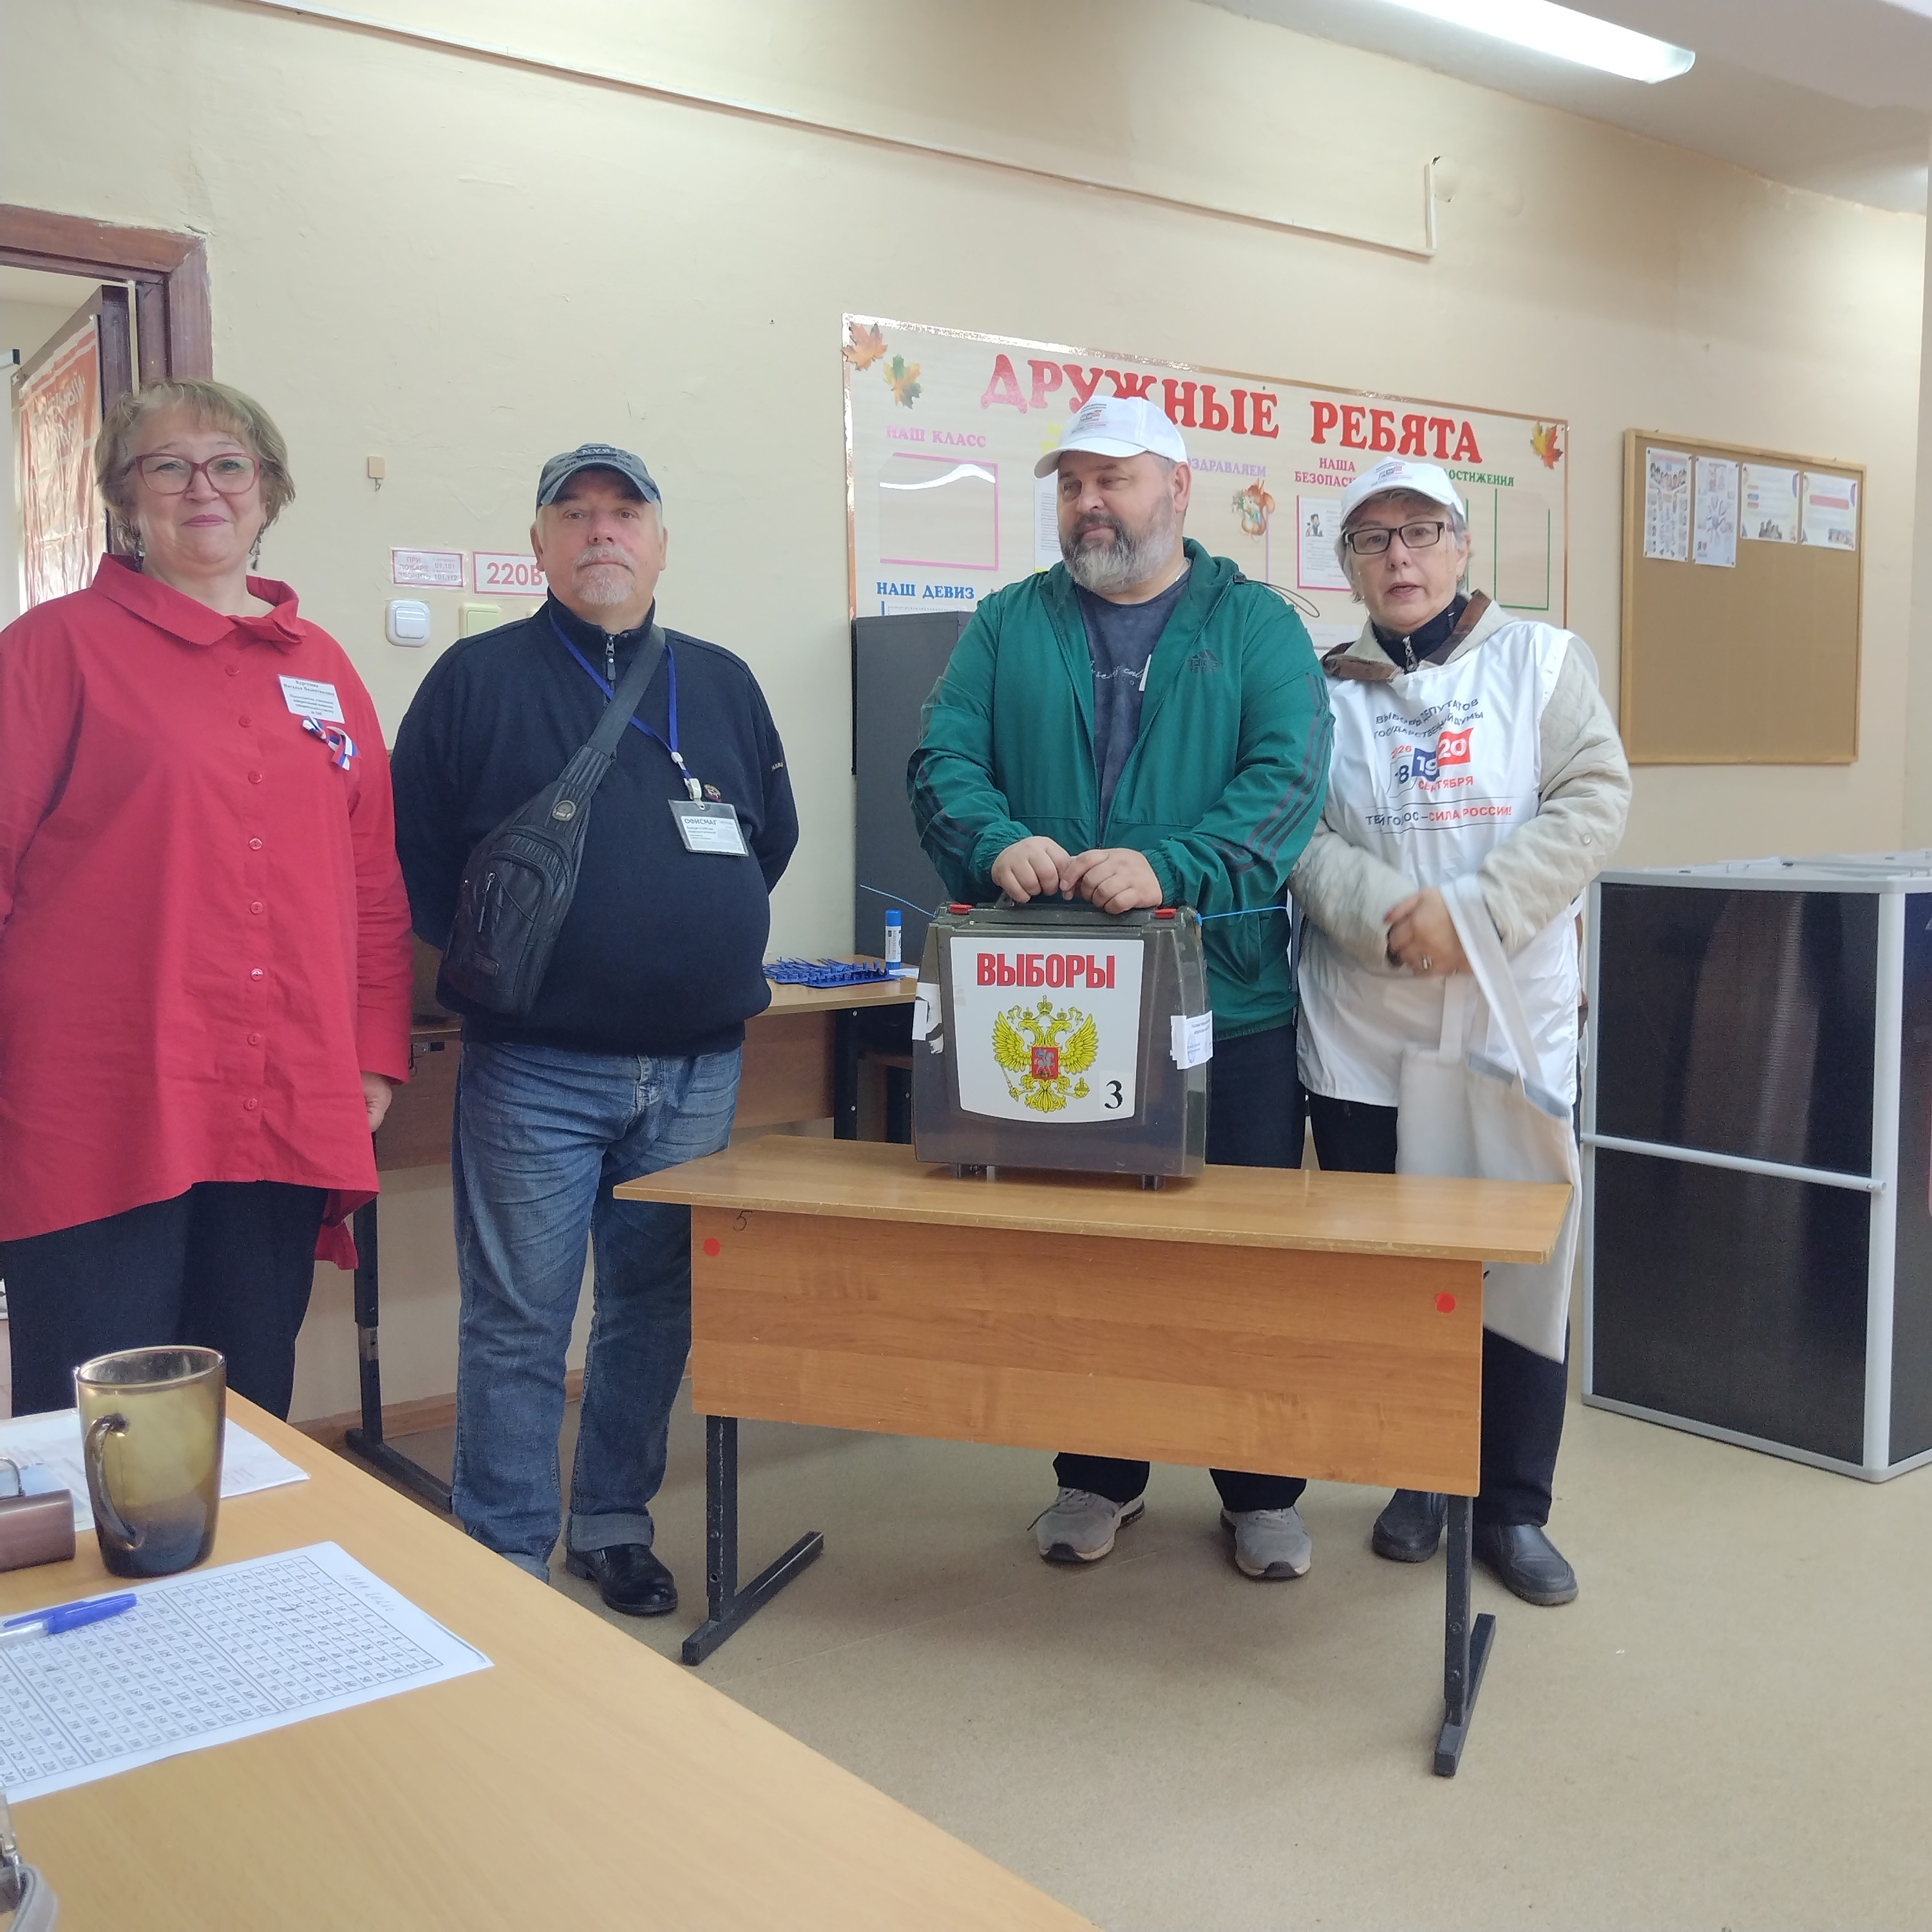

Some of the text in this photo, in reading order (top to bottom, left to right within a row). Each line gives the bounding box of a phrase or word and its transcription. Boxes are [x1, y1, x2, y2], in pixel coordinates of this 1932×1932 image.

[981, 354, 1279, 439] ДРУЖНЫЕ
[1310, 401, 1482, 464] РЕБЯТА
[886, 425, 987, 448] НАШ КЛАСС
[1188, 457, 1266, 477] ЗДРАВЛЯЕМ
[1319, 457, 1356, 472] НАША
[1444, 468, 1515, 487] ОСТИЖЕНИЯ
[487, 562, 543, 586] 220В
[876, 582, 974, 599] НАШ ДЕВИЗ
[1454, 712, 1483, 726] ДУМЫ
[1438, 738, 1466, 760] 20
[1429, 811, 1461, 821] СИЛА
[978, 953, 1115, 989] ВЫБОРЫ
[1104, 1080, 1123, 1109] 3
[733, 1210, 753, 1232] 5
